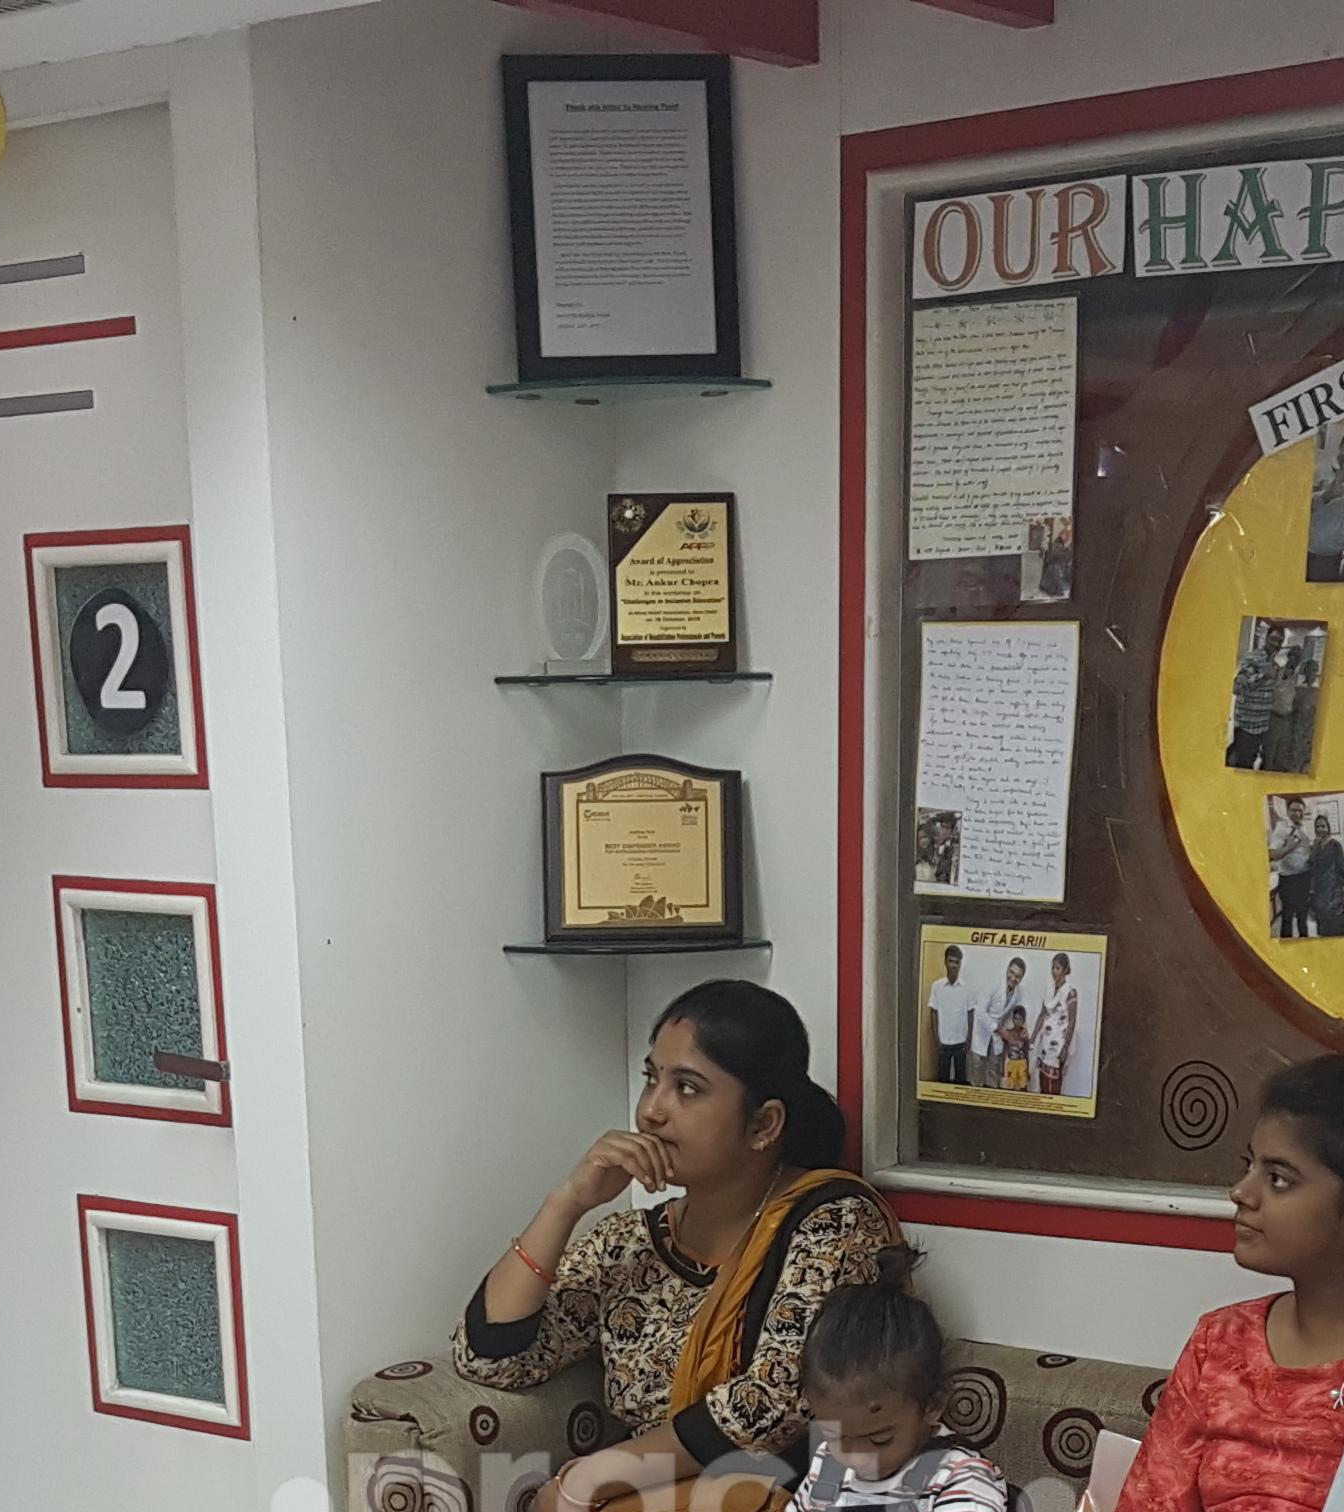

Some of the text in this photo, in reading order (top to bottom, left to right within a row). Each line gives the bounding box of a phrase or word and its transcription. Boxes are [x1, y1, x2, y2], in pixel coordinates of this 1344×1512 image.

[923, 182, 1117, 291] OUR
[96, 603, 146, 708] 2
[971, 932, 997, 944] GIFT
[999, 933, 1007, 945] A
